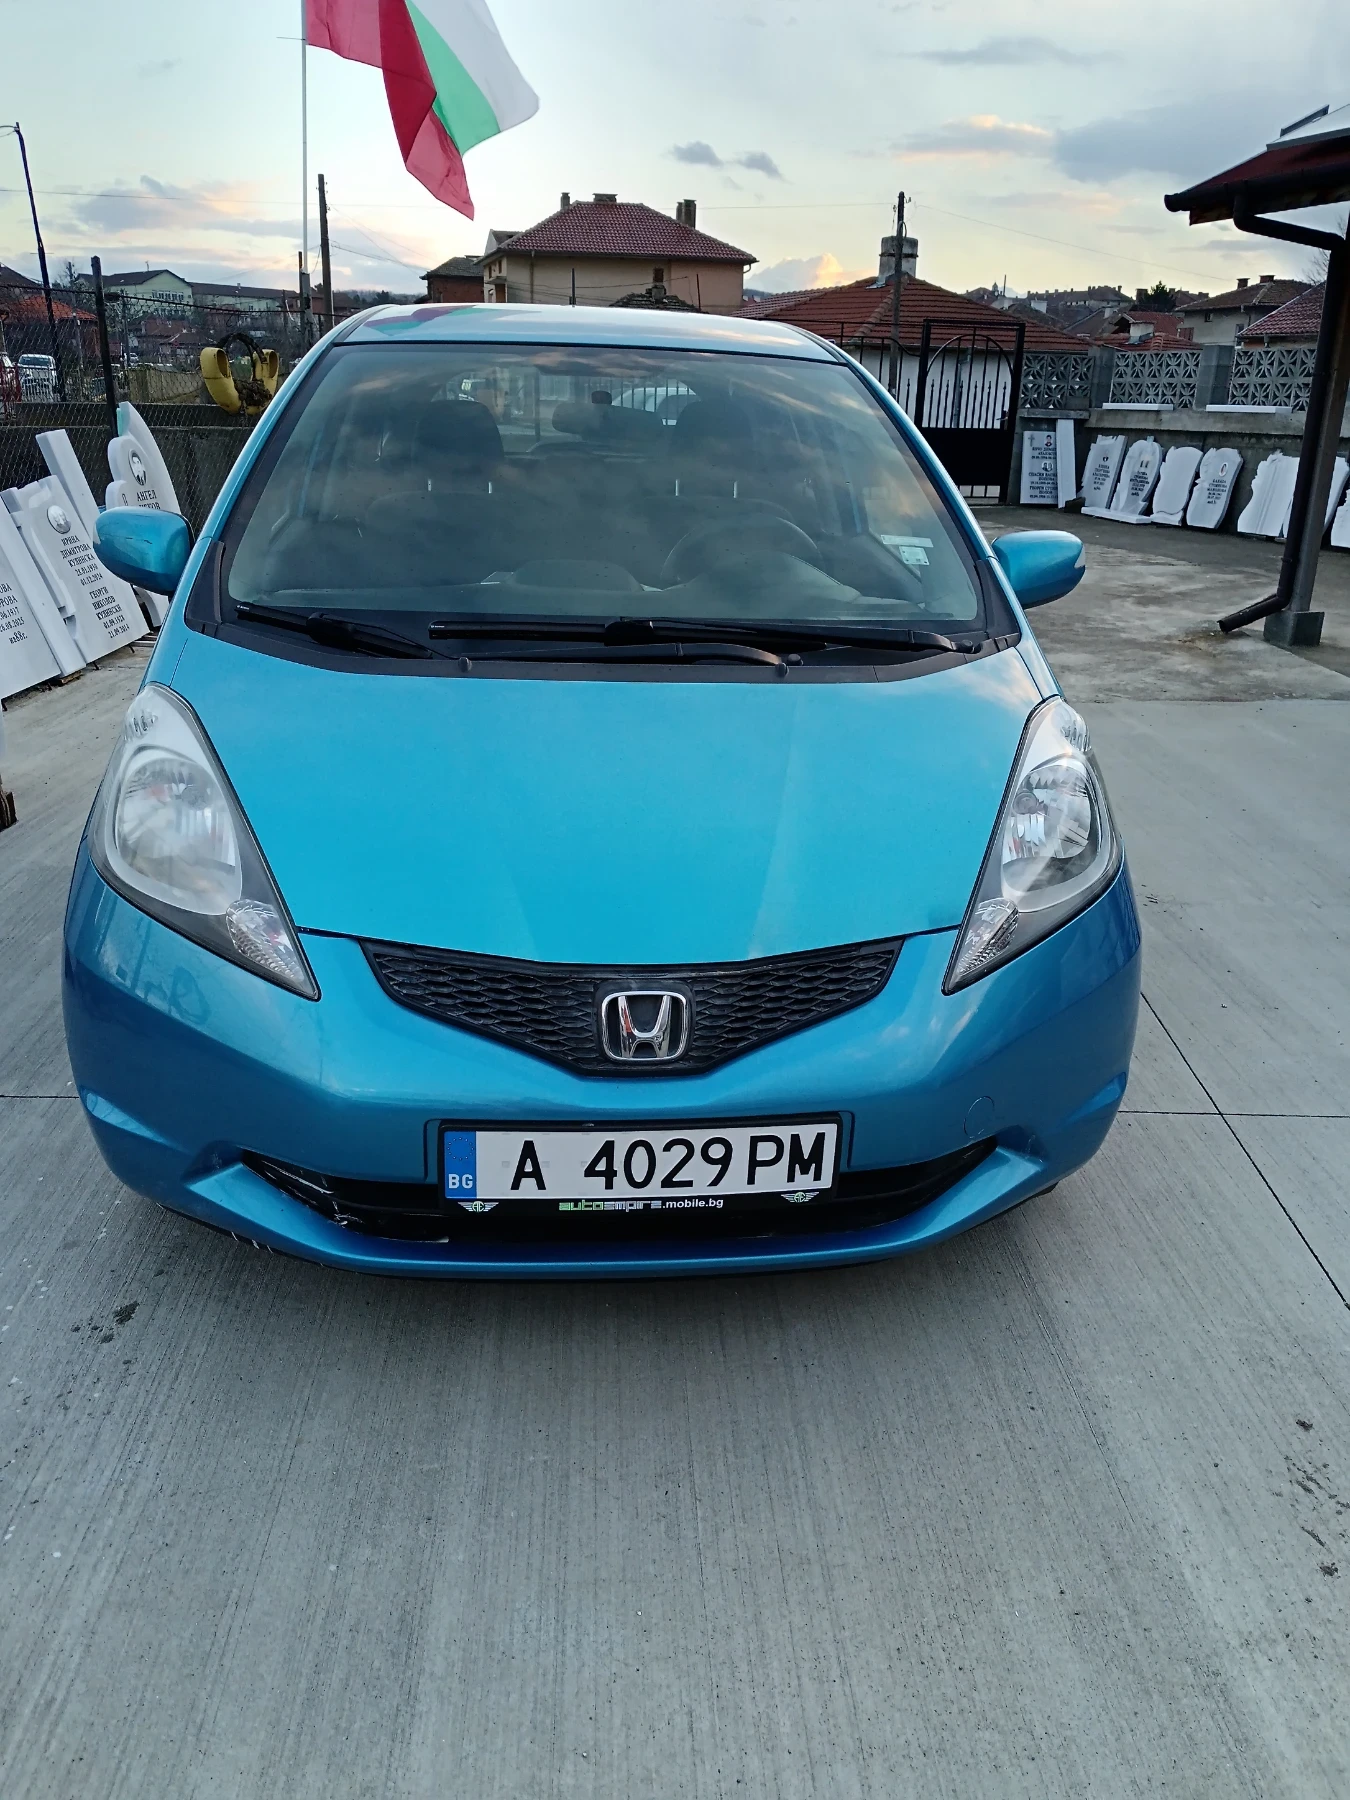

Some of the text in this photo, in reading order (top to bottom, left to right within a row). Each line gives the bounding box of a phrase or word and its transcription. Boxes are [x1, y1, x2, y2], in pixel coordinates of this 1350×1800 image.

[137, 490, 157, 502] АНГЕЛ
[61, 535, 80, 546] ИРИНА
[60, 543, 91, 559] ДИМИТРОВА
[89, 586, 109, 599] ГЕОРГИ
[92, 596, 116, 610] НИКОЛОВ
[510, 1132, 826, 1190] A 4029 PM
[448, 1173, 473, 1189] BG
